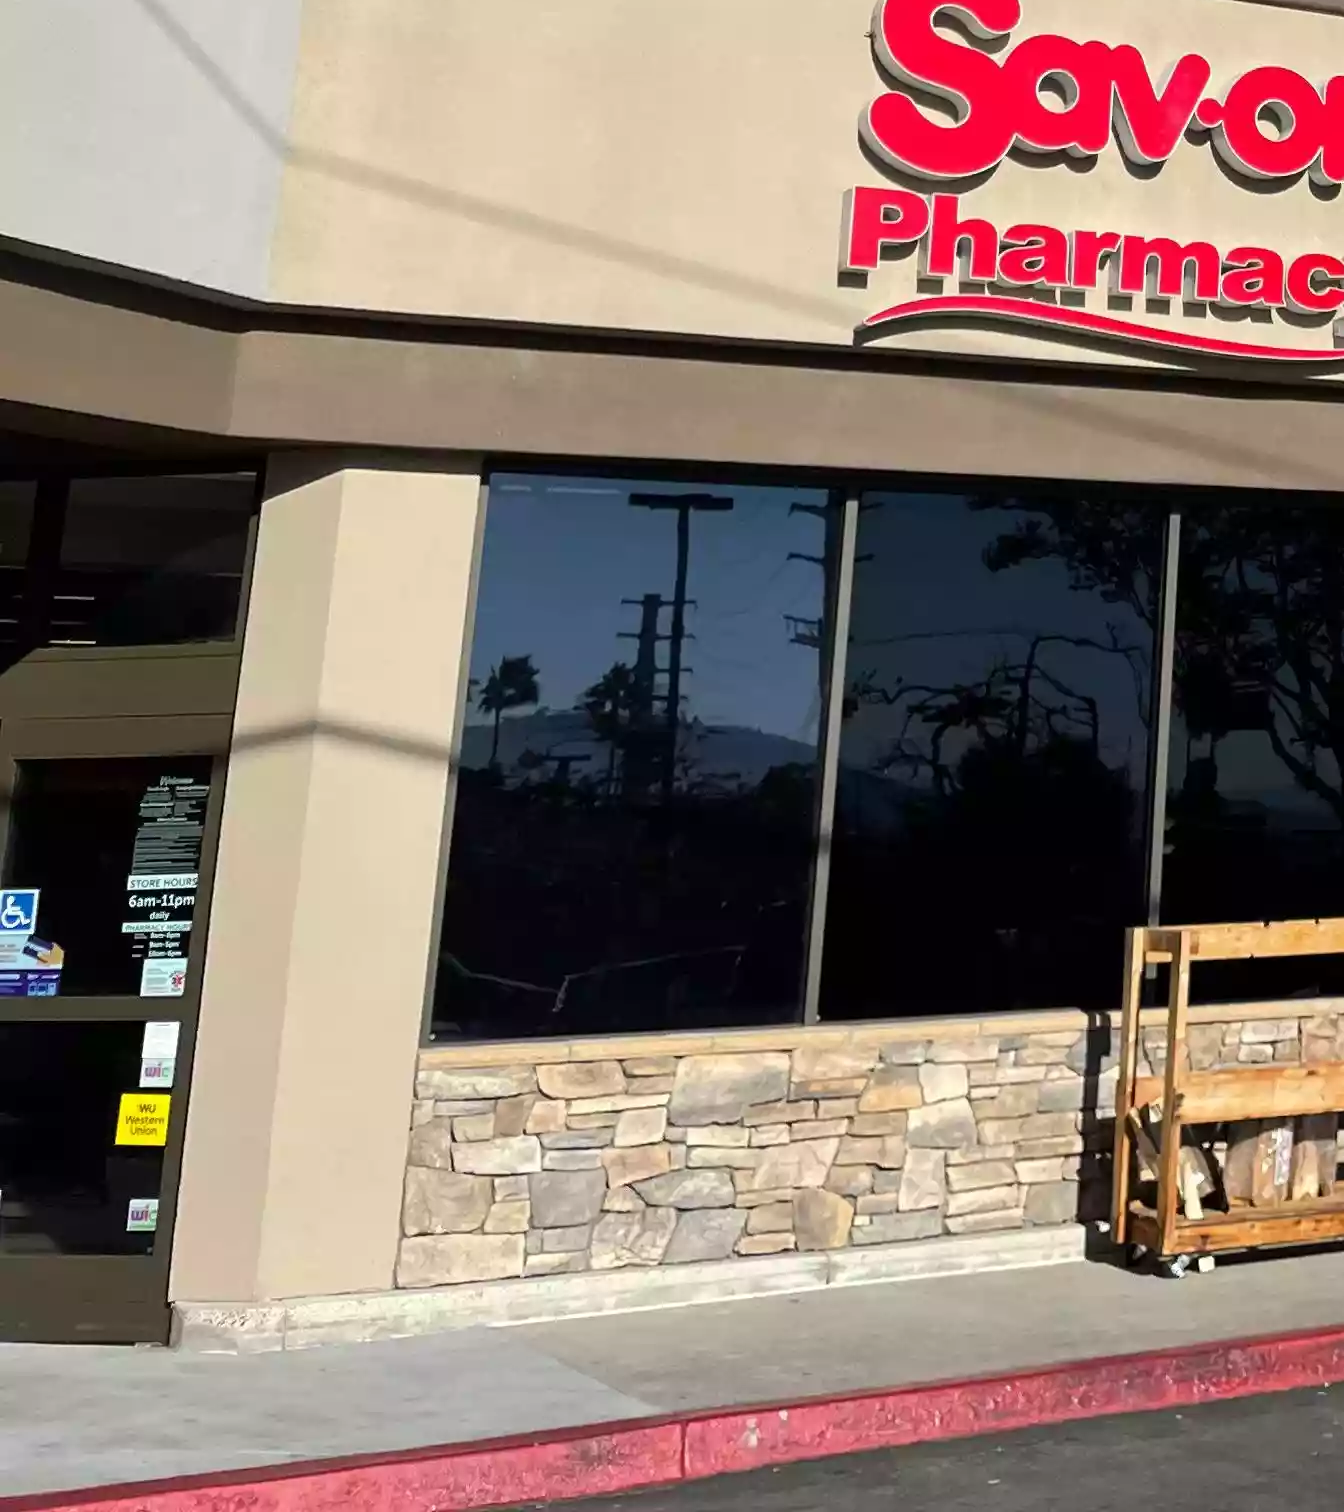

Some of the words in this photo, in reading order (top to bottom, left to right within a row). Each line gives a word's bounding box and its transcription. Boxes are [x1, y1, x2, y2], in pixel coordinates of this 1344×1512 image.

[130, 878, 162, 889] STORE
[163, 877, 198, 888] HOURS
[128, 893, 195, 909] 6am-11pm
[149, 910, 170, 921] daily
[125, 1115, 165, 1125] Western
[130, 1125, 158, 1136] Union
